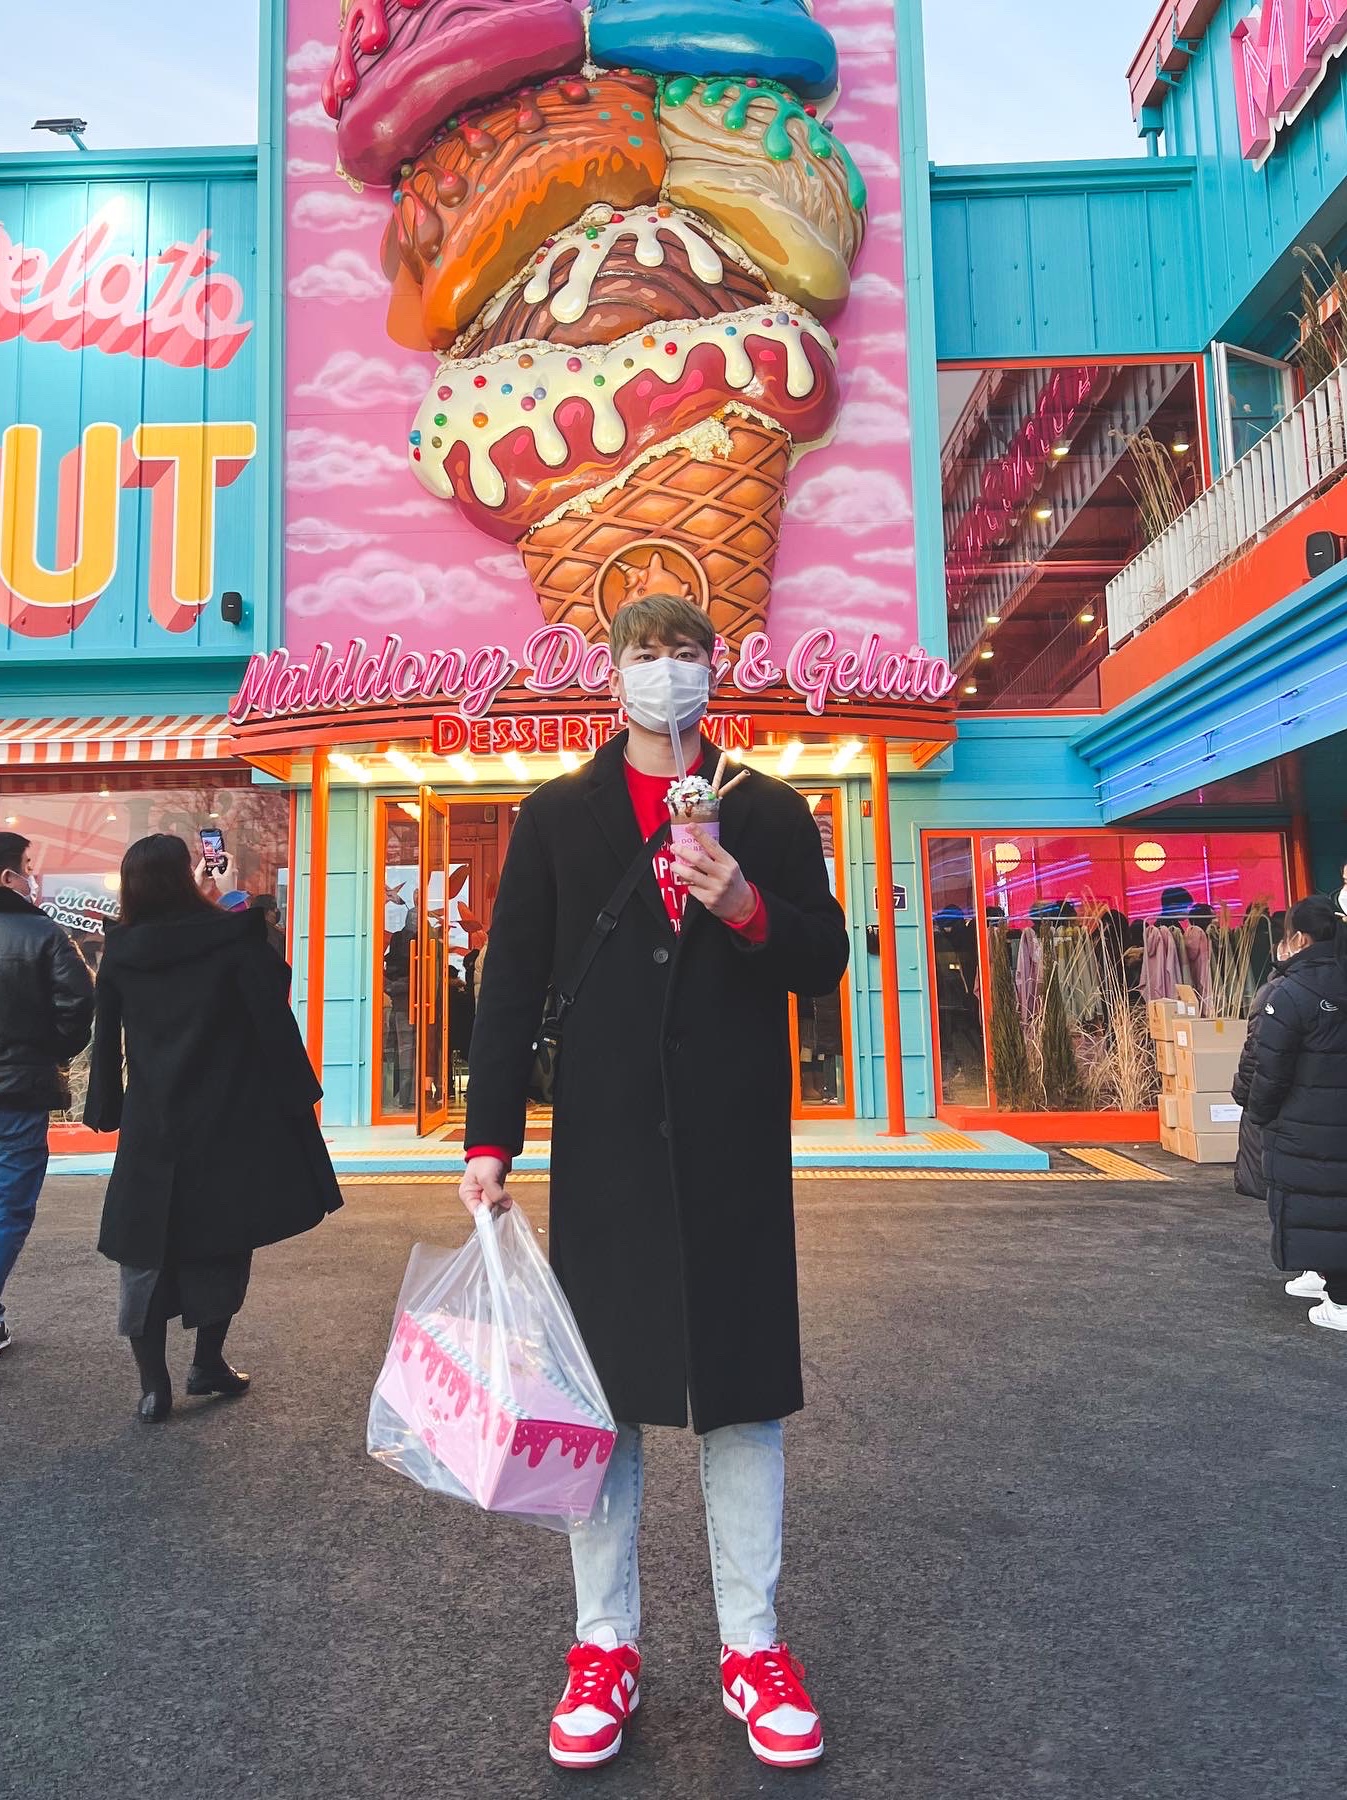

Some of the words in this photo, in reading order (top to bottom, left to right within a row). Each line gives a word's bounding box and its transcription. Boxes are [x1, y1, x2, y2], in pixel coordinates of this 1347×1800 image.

[0, 196, 254, 348] elato
[228, 634, 519, 720] Malddong
[524, 624, 731, 693] Dot
[733, 632, 783, 694] &
[786, 627, 958, 715] Gelato
[432, 713, 616, 757] DESSERT
[40, 902, 106, 936] Desser
